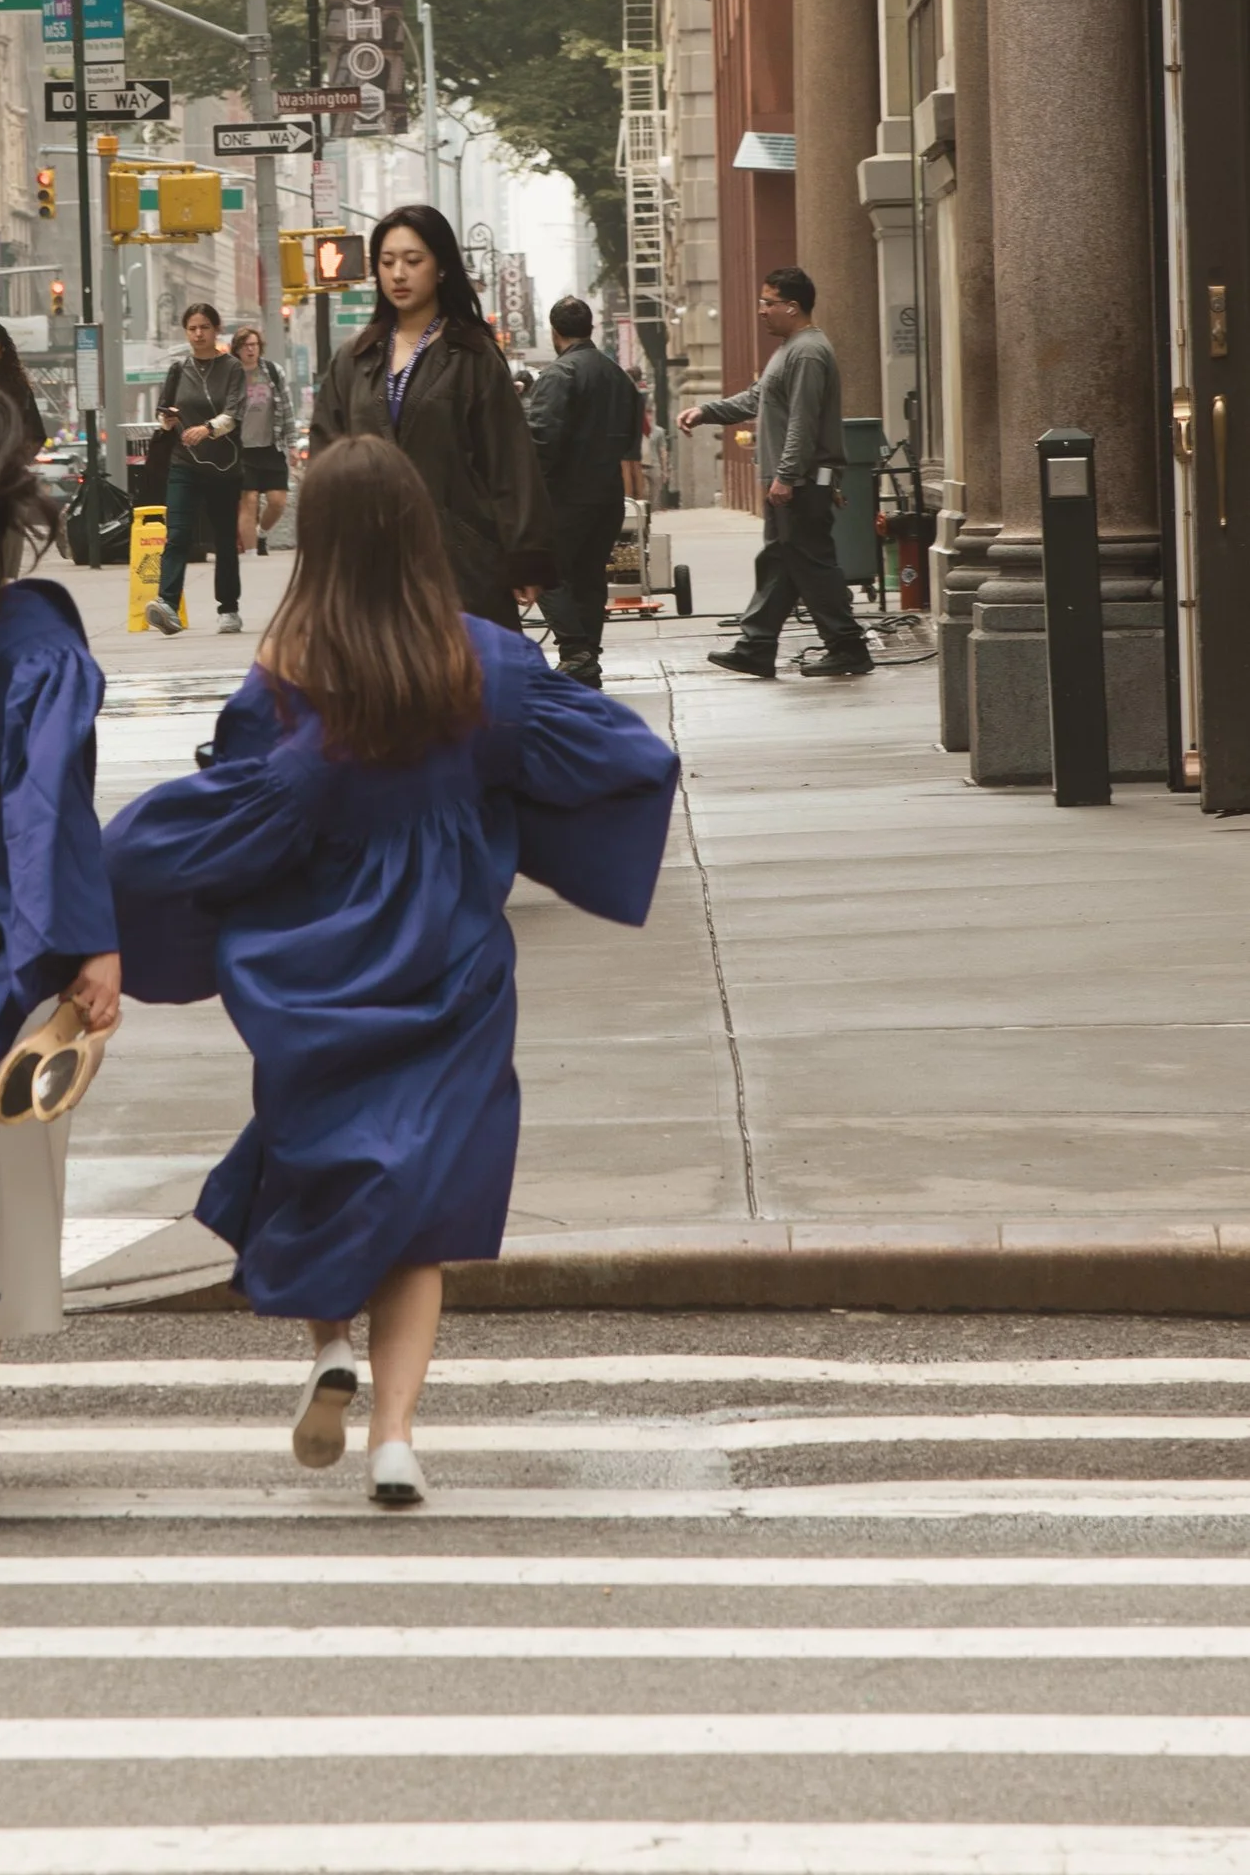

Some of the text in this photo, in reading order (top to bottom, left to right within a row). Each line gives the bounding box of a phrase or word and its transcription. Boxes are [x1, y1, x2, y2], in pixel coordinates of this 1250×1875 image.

[44, 21, 67, 38] M55
[62, 93, 152, 109] OE WAY
[278, 92, 358, 108] Washington
[222, 131, 300, 147] ONE WAY
